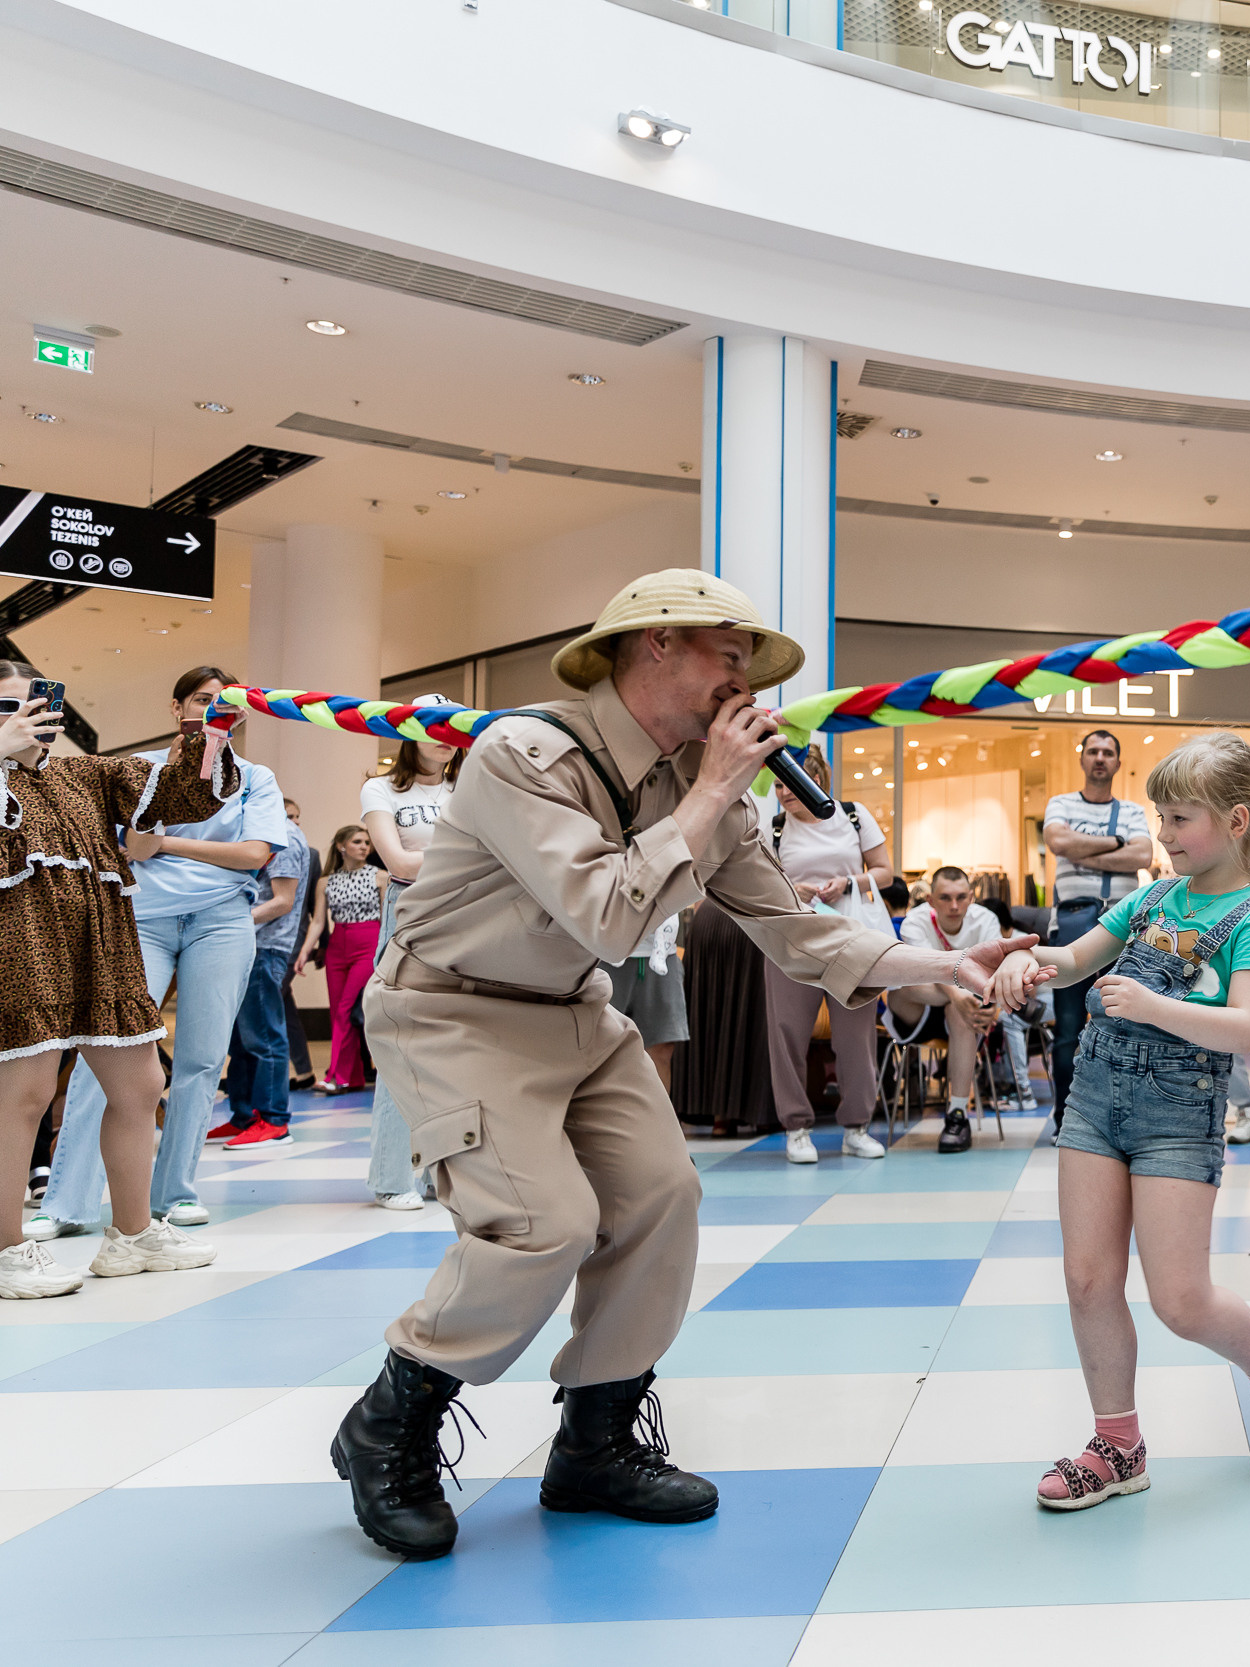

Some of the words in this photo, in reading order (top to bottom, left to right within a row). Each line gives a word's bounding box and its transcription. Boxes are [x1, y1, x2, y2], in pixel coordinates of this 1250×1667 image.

[946, 10, 1152, 96] GATTOI
[50, 517, 115, 537] SOKOLOV
[49, 529, 100, 547] TEZENIS
